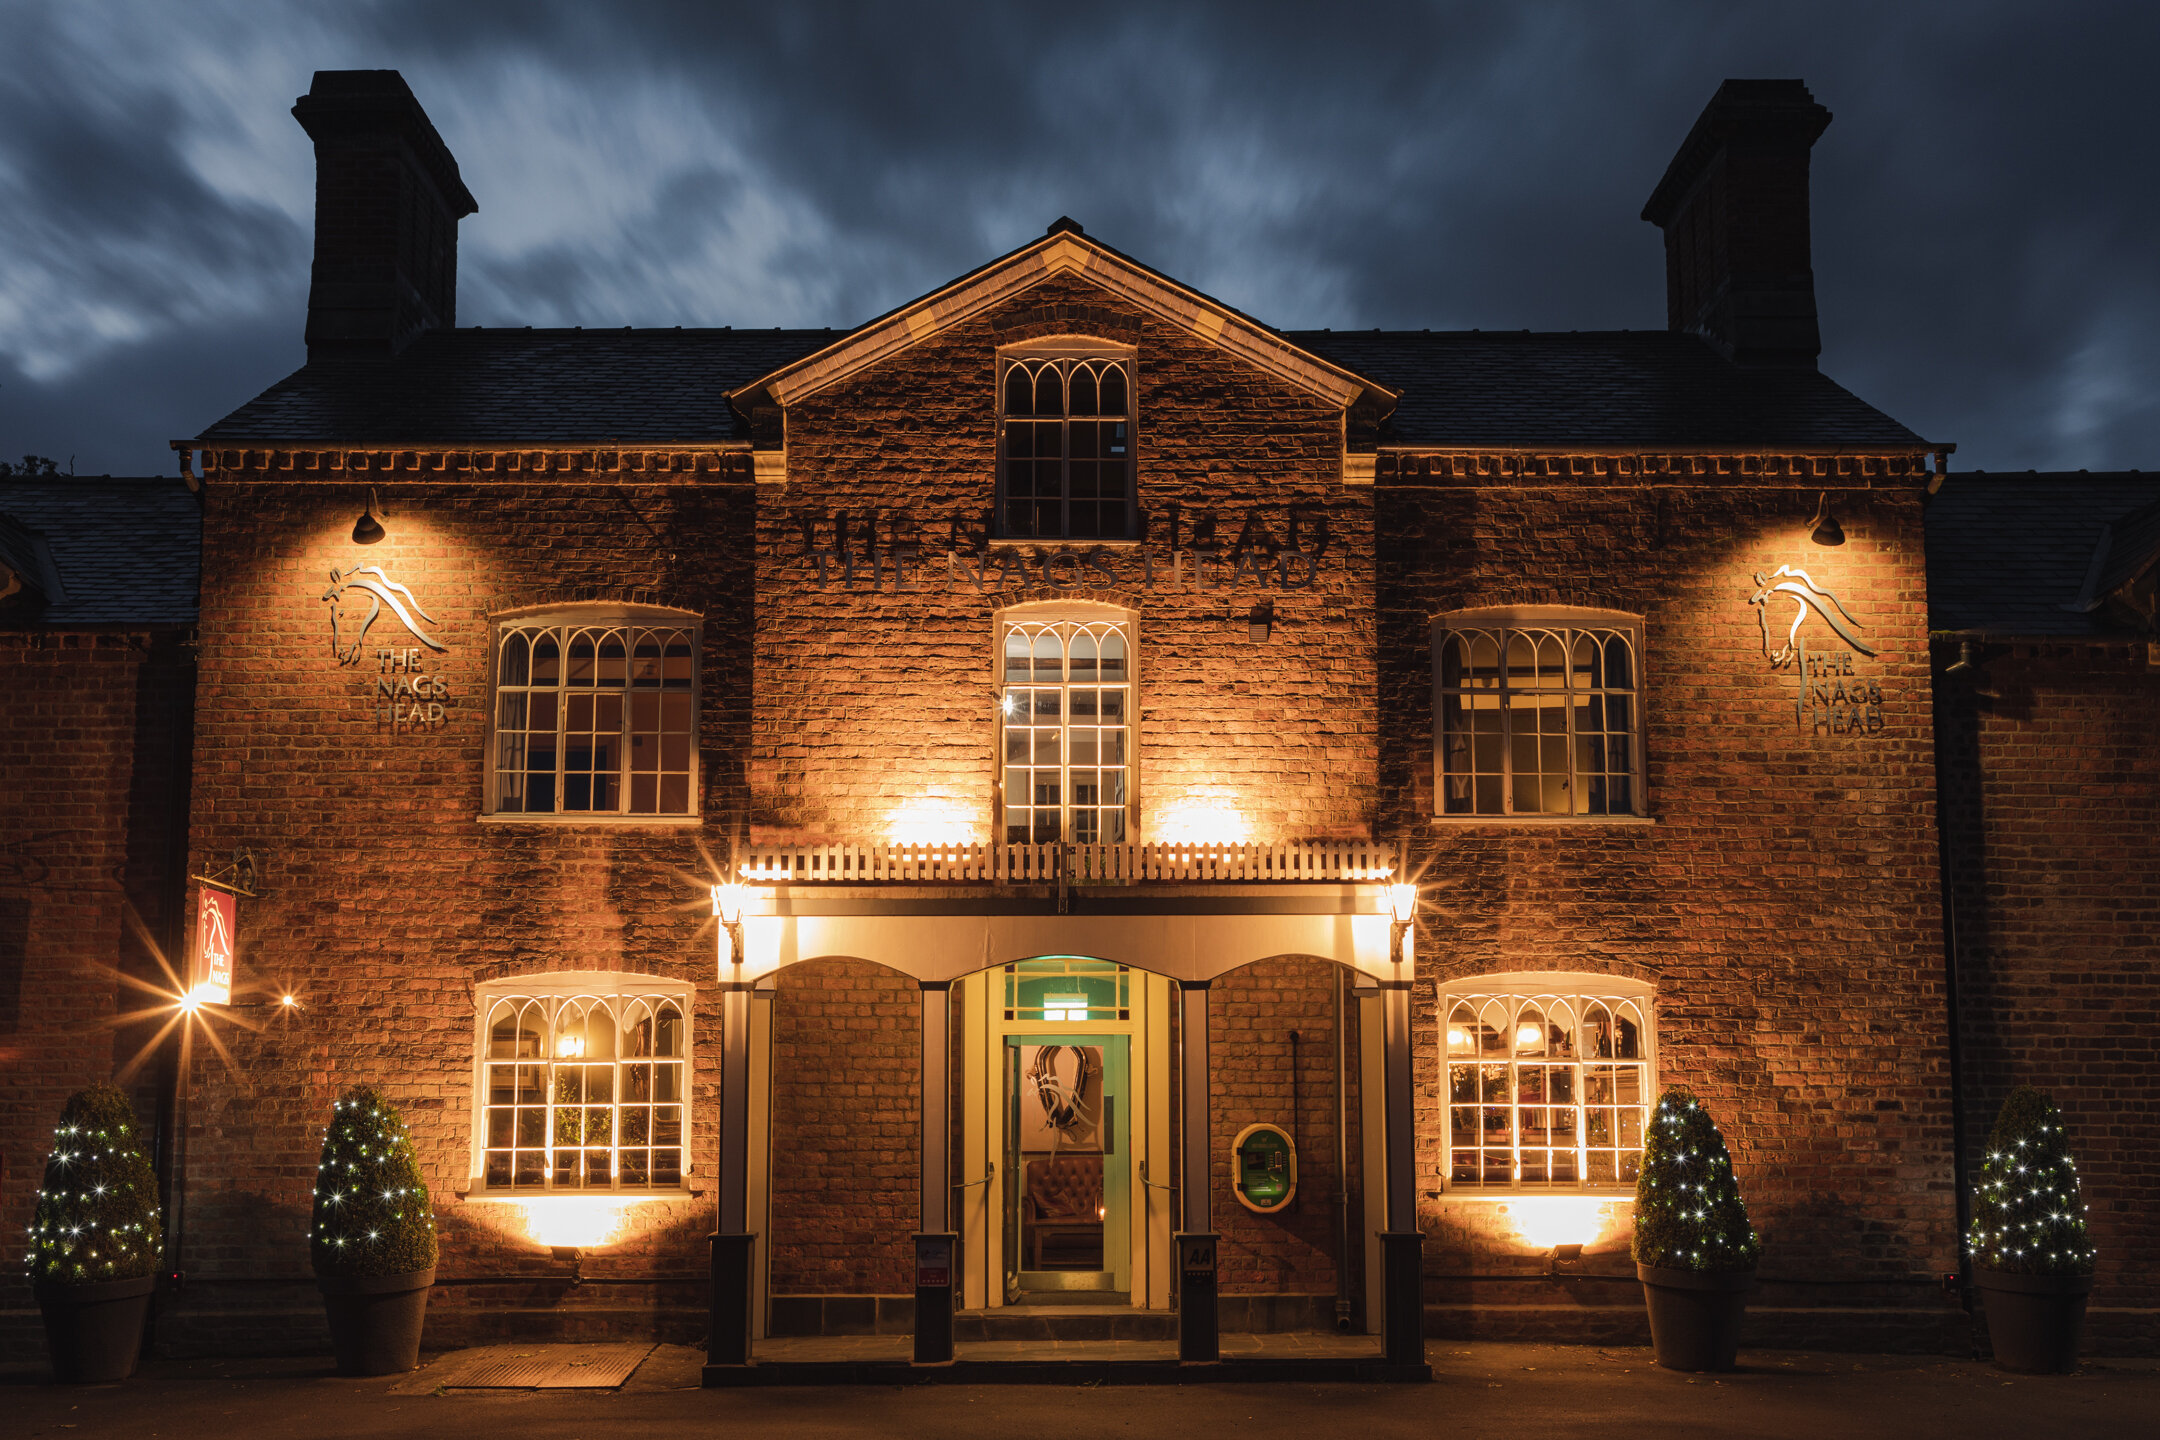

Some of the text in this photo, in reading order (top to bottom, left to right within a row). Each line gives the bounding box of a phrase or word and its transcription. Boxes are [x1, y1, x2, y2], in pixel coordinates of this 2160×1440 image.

[806, 550, 1318, 591] THE NAGS HEAD
[377, 648, 421, 667] THE
[1808, 651, 1853, 670] THE
[377, 675, 447, 695] NAGS
[1812, 678, 1881, 698] NAGS
[376, 703, 445, 722] HEAD
[1813, 706, 1882, 725] HEAD
[213, 953, 225, 966] THE
[1188, 1248, 1210, 1265] AA
